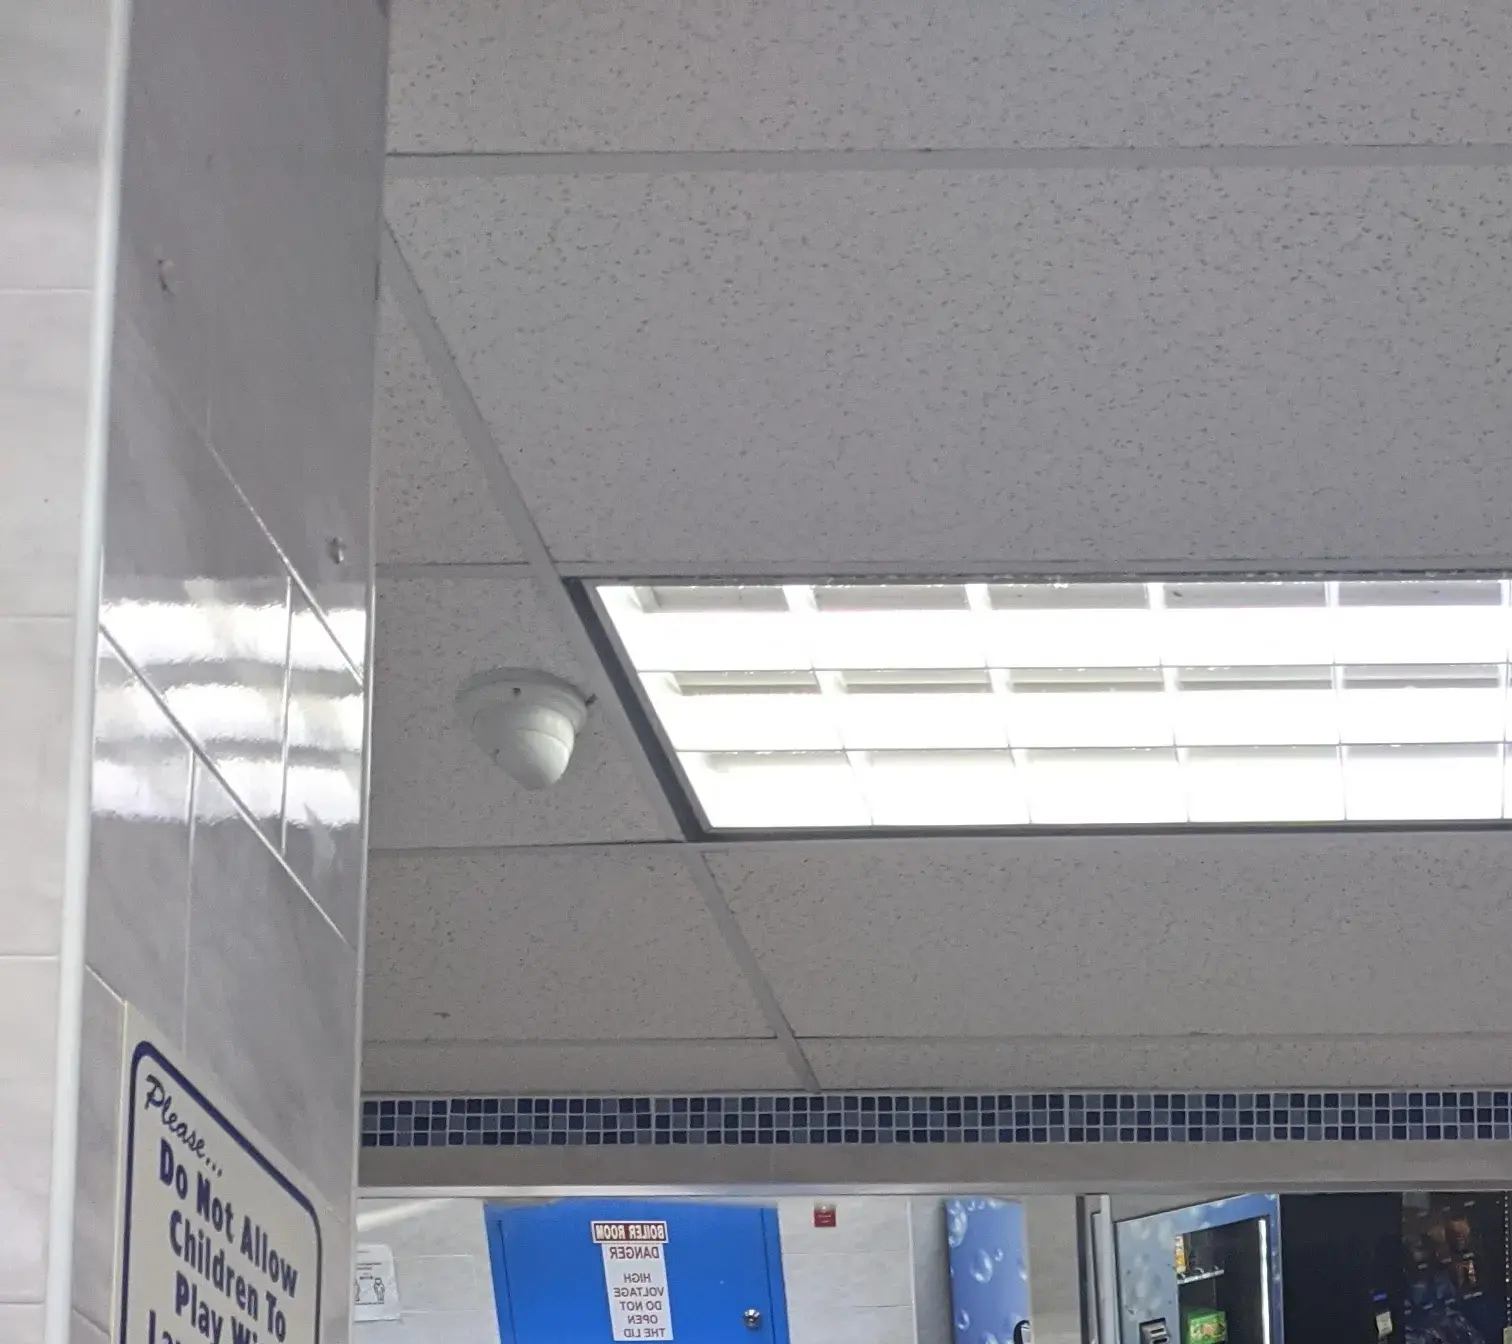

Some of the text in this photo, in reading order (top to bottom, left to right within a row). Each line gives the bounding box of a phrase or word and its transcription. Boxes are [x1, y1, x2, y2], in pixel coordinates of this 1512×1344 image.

[145, 1074, 223, 1178] Please...
[159, 1137, 299, 1299] Do Not Allow
[169, 1210, 287, 1344] Children To
